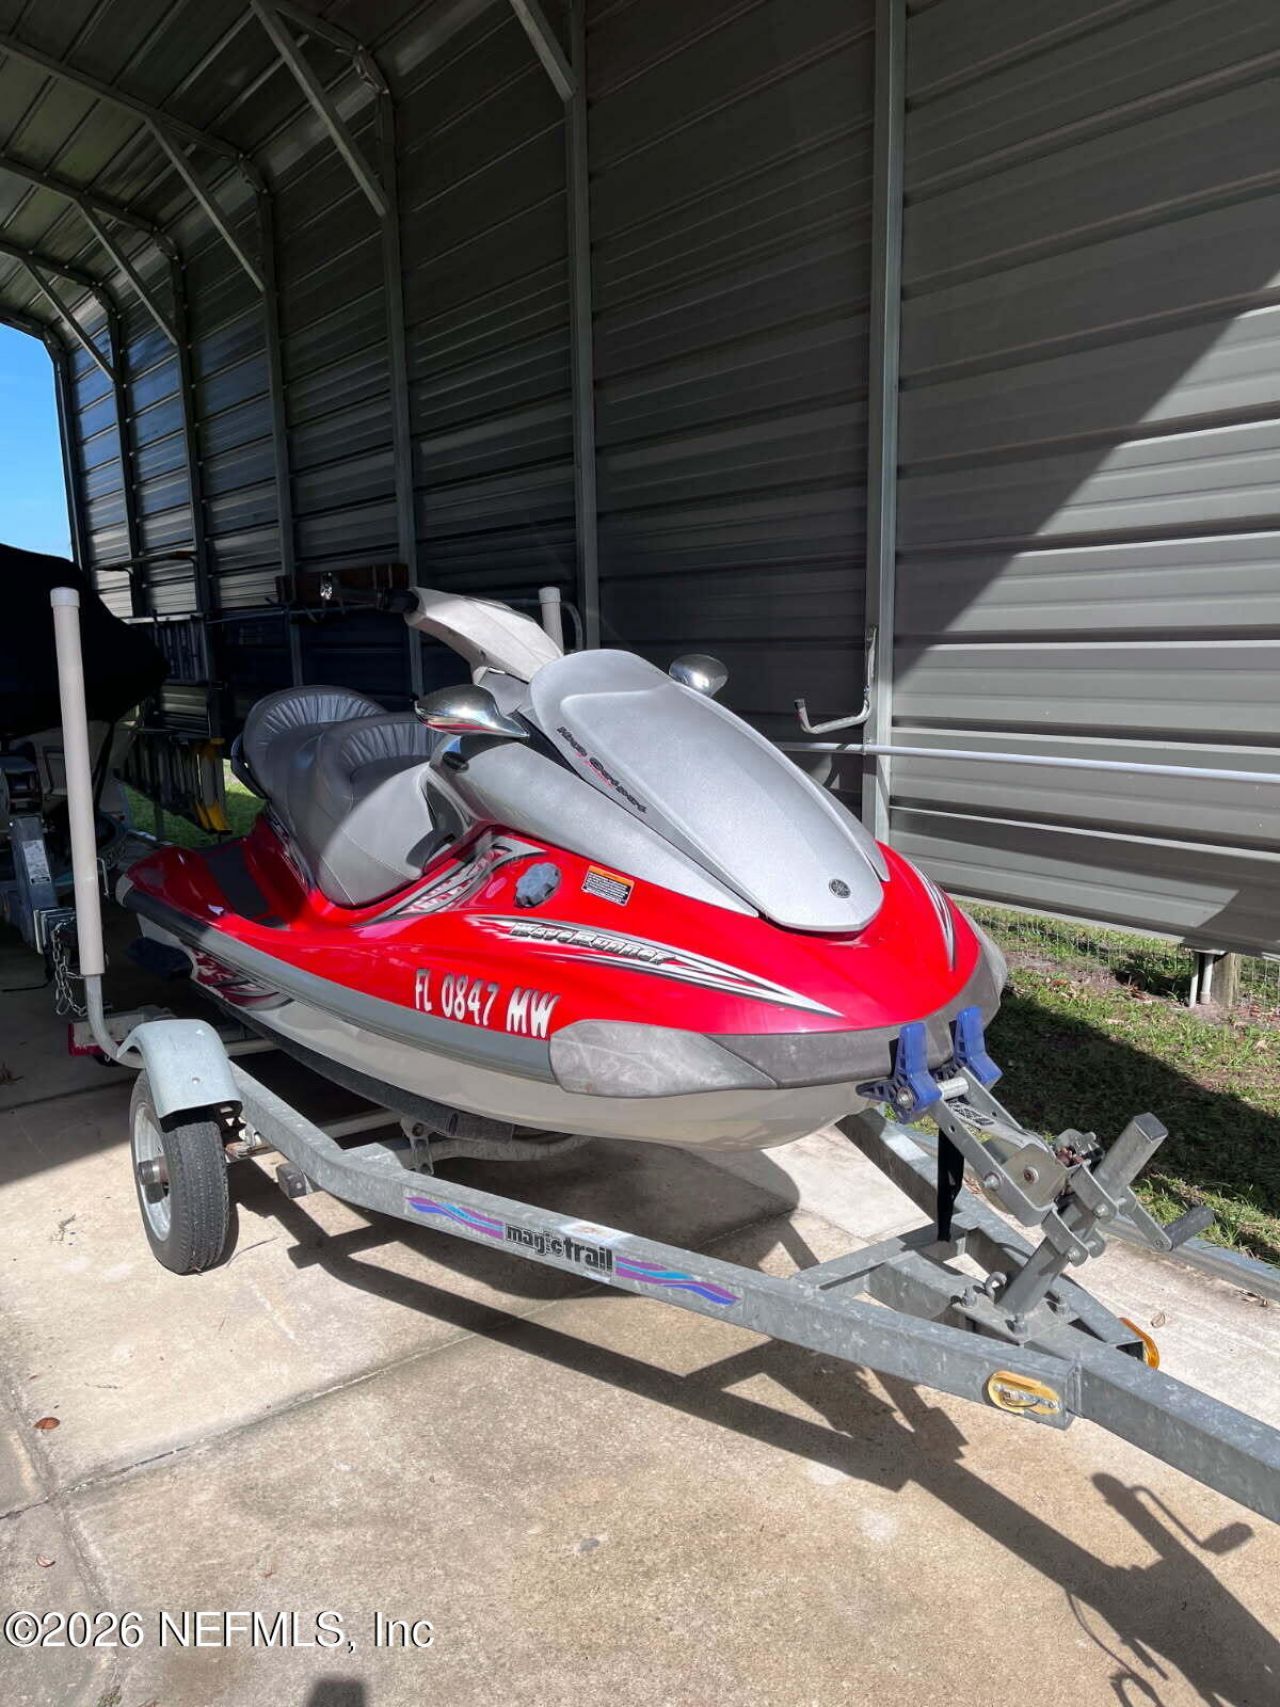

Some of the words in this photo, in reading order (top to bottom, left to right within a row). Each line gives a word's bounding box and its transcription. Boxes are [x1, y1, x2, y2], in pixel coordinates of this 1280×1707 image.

[415, 968, 432, 1012] FL
[441, 973, 499, 1027] 0847
[506, 986, 560, 1038] MW
